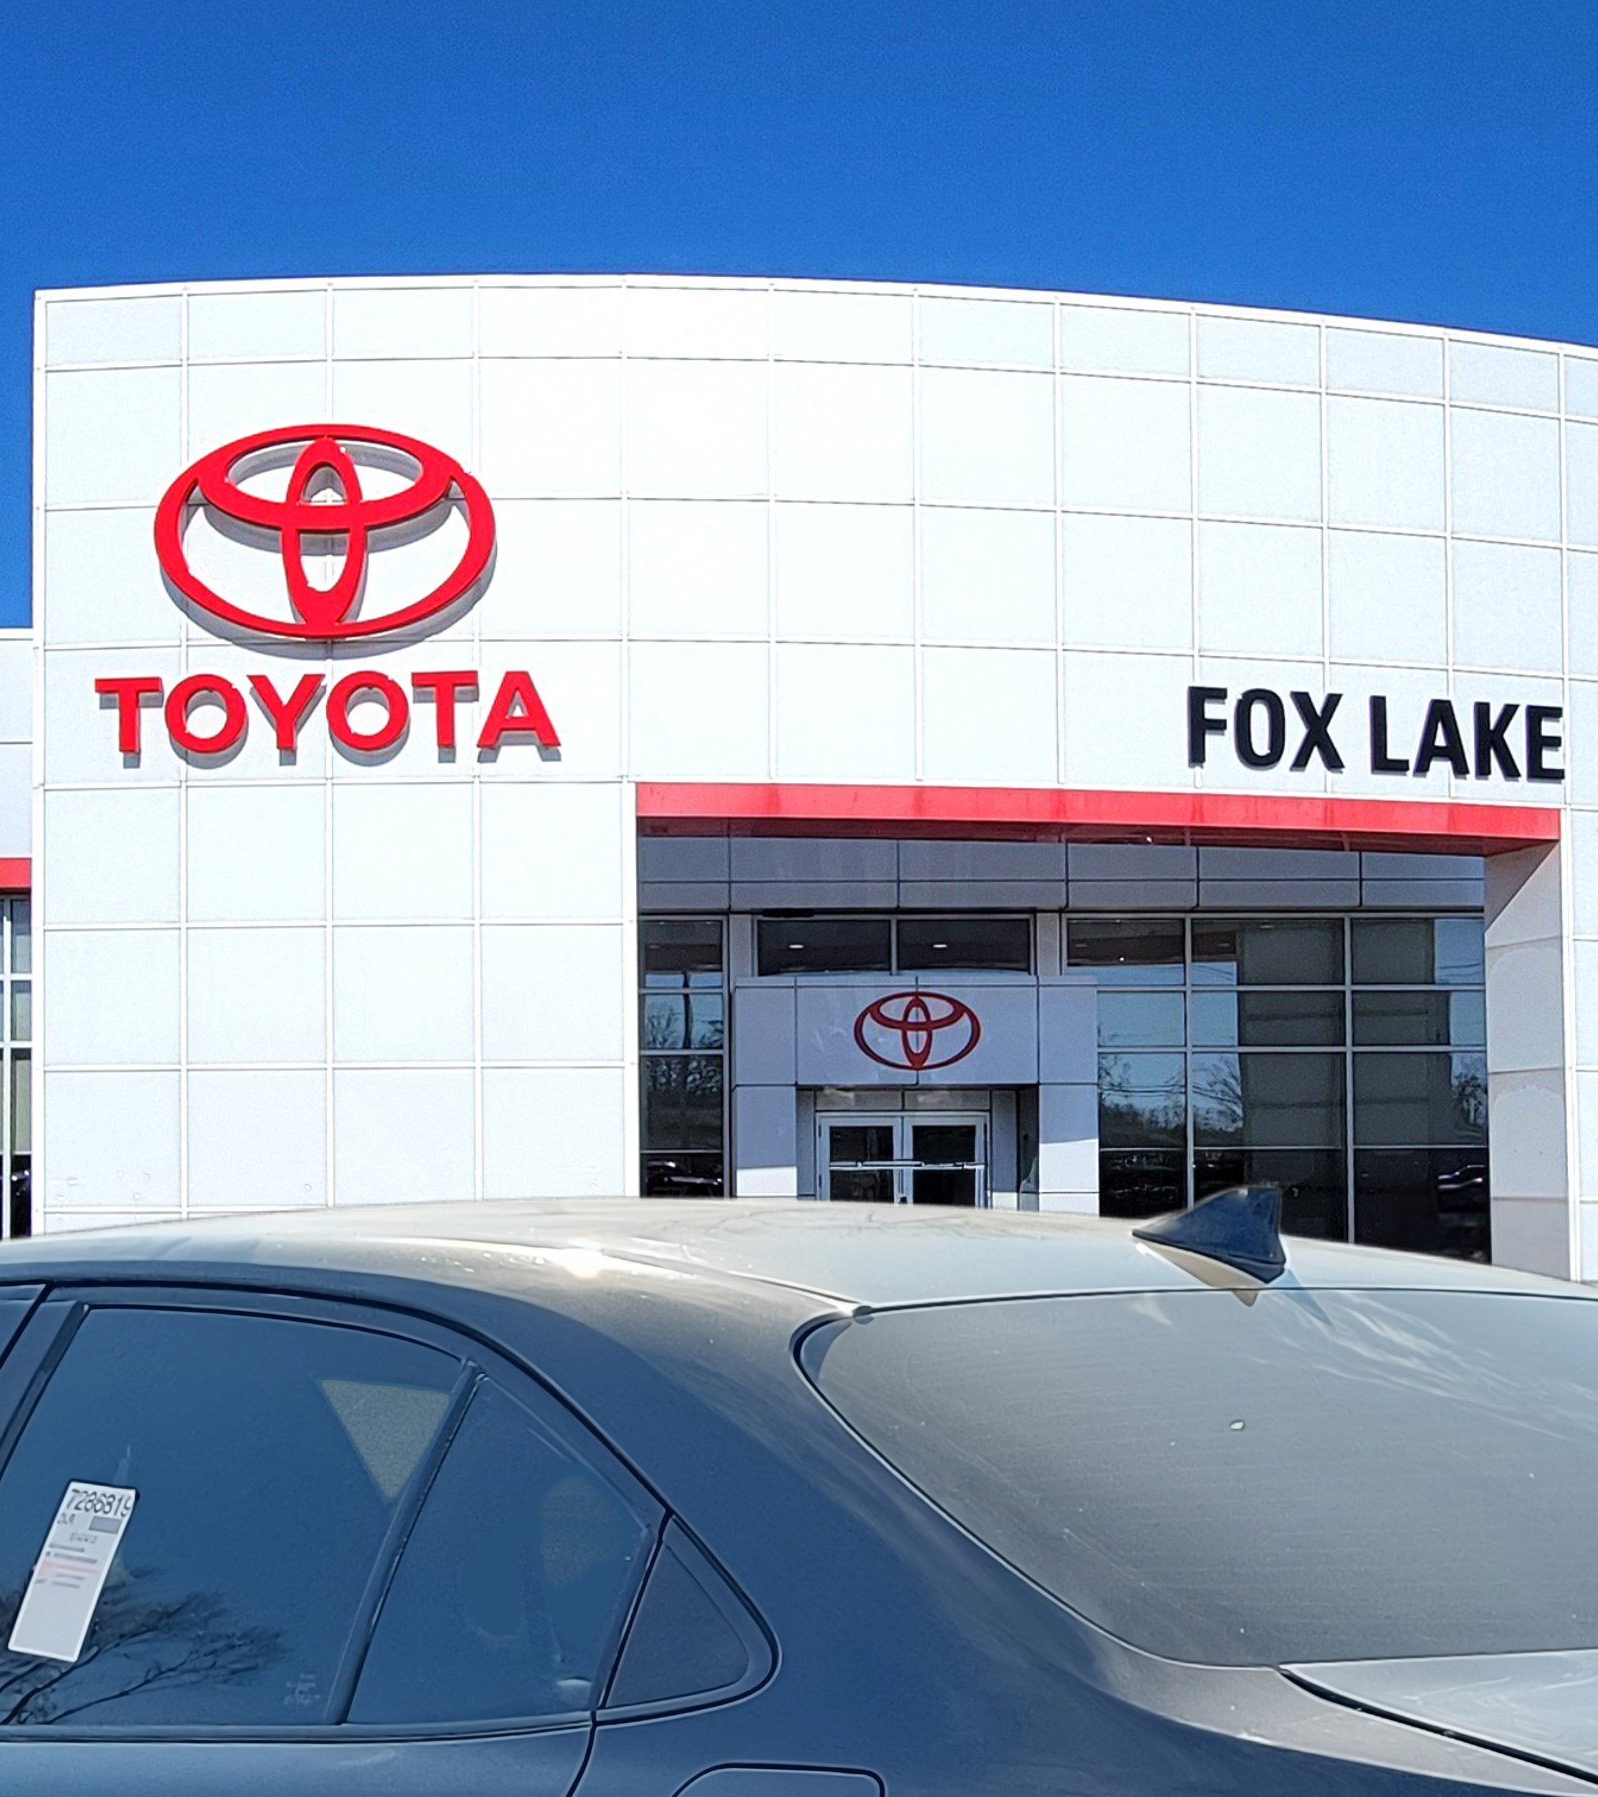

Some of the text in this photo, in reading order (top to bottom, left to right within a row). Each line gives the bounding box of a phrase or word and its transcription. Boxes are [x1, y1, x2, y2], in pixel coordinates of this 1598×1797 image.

[95, 670, 561, 758] TOYOTA
[1187, 685, 1565, 780] FOX LAKE
